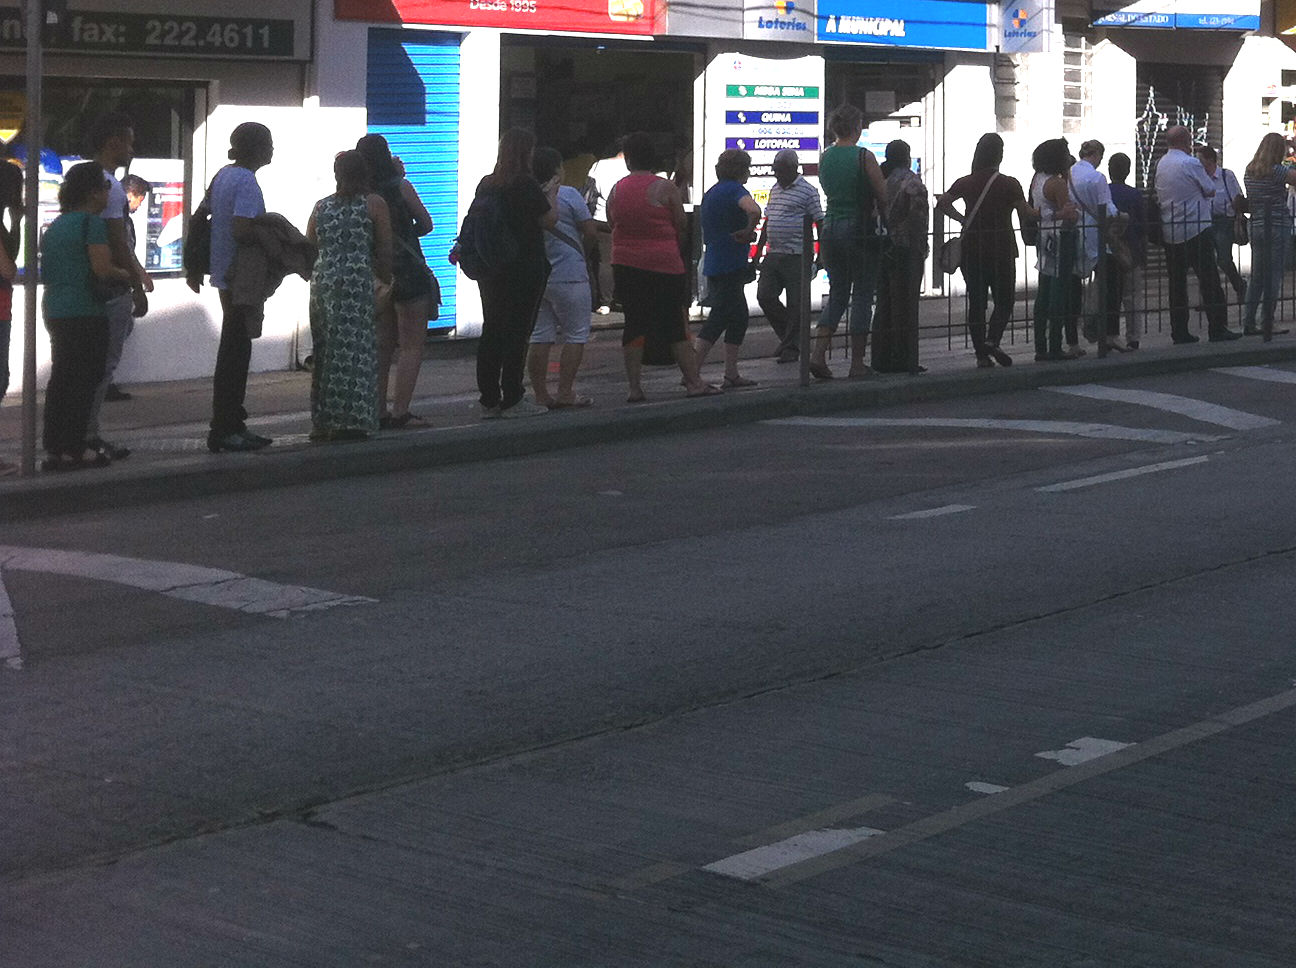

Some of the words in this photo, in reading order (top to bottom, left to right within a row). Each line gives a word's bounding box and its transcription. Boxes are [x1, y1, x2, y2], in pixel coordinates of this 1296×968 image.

[71, 16, 126, 44] fax:
[145, 19, 271, 48] 222.4611
[761, 112, 792, 123] QUINA
